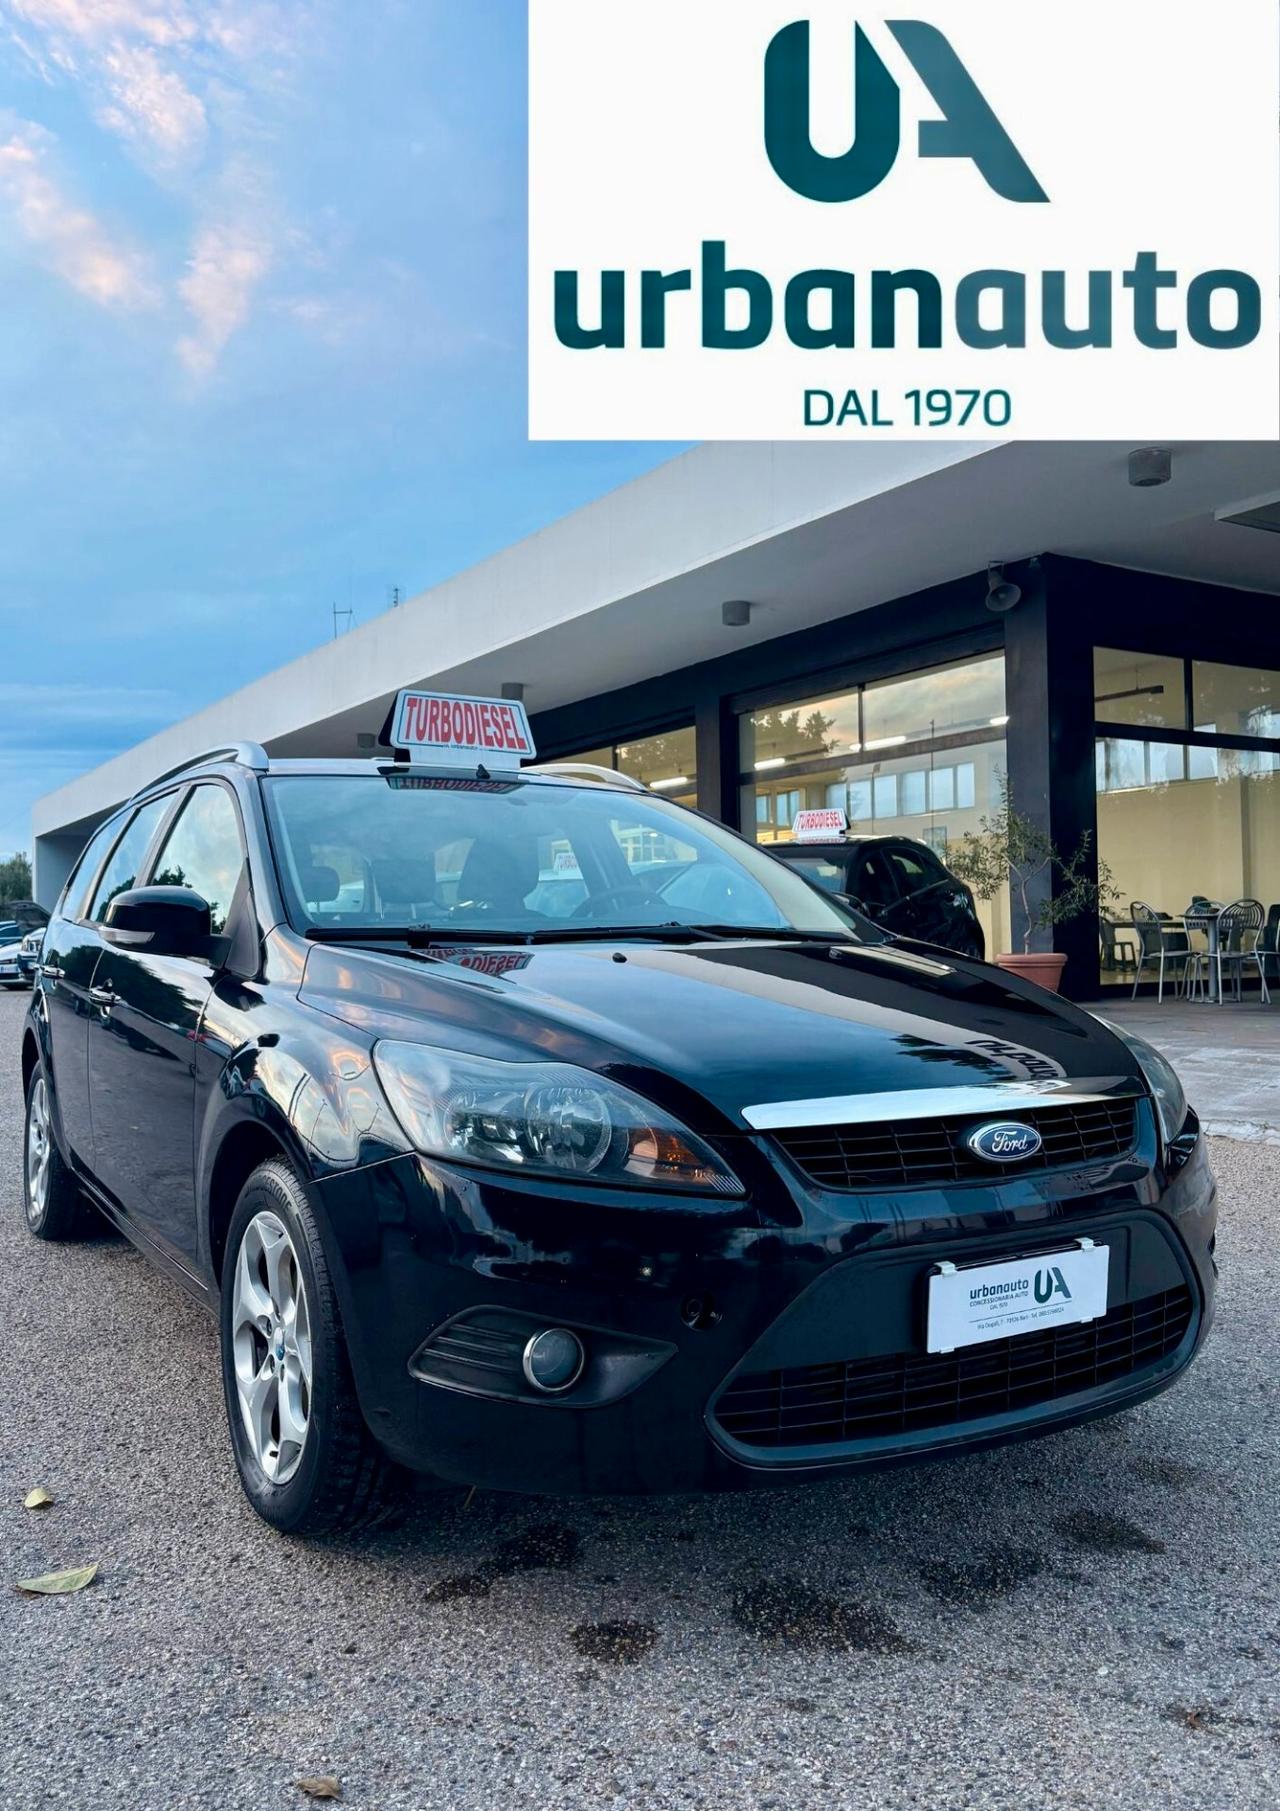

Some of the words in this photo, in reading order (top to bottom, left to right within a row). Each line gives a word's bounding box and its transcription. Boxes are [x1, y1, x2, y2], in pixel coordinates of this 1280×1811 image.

[405, 697, 527, 750] TURBODIESEL
[798, 811, 843, 830] TURBODIESEL
[991, 1130, 1029, 1153] Ford
[970, 1279, 1029, 1300] urbanauto
[970, 1293, 1014, 1307] CONCESSIONARIA
[1015, 1291, 1029, 1300] AUTO
